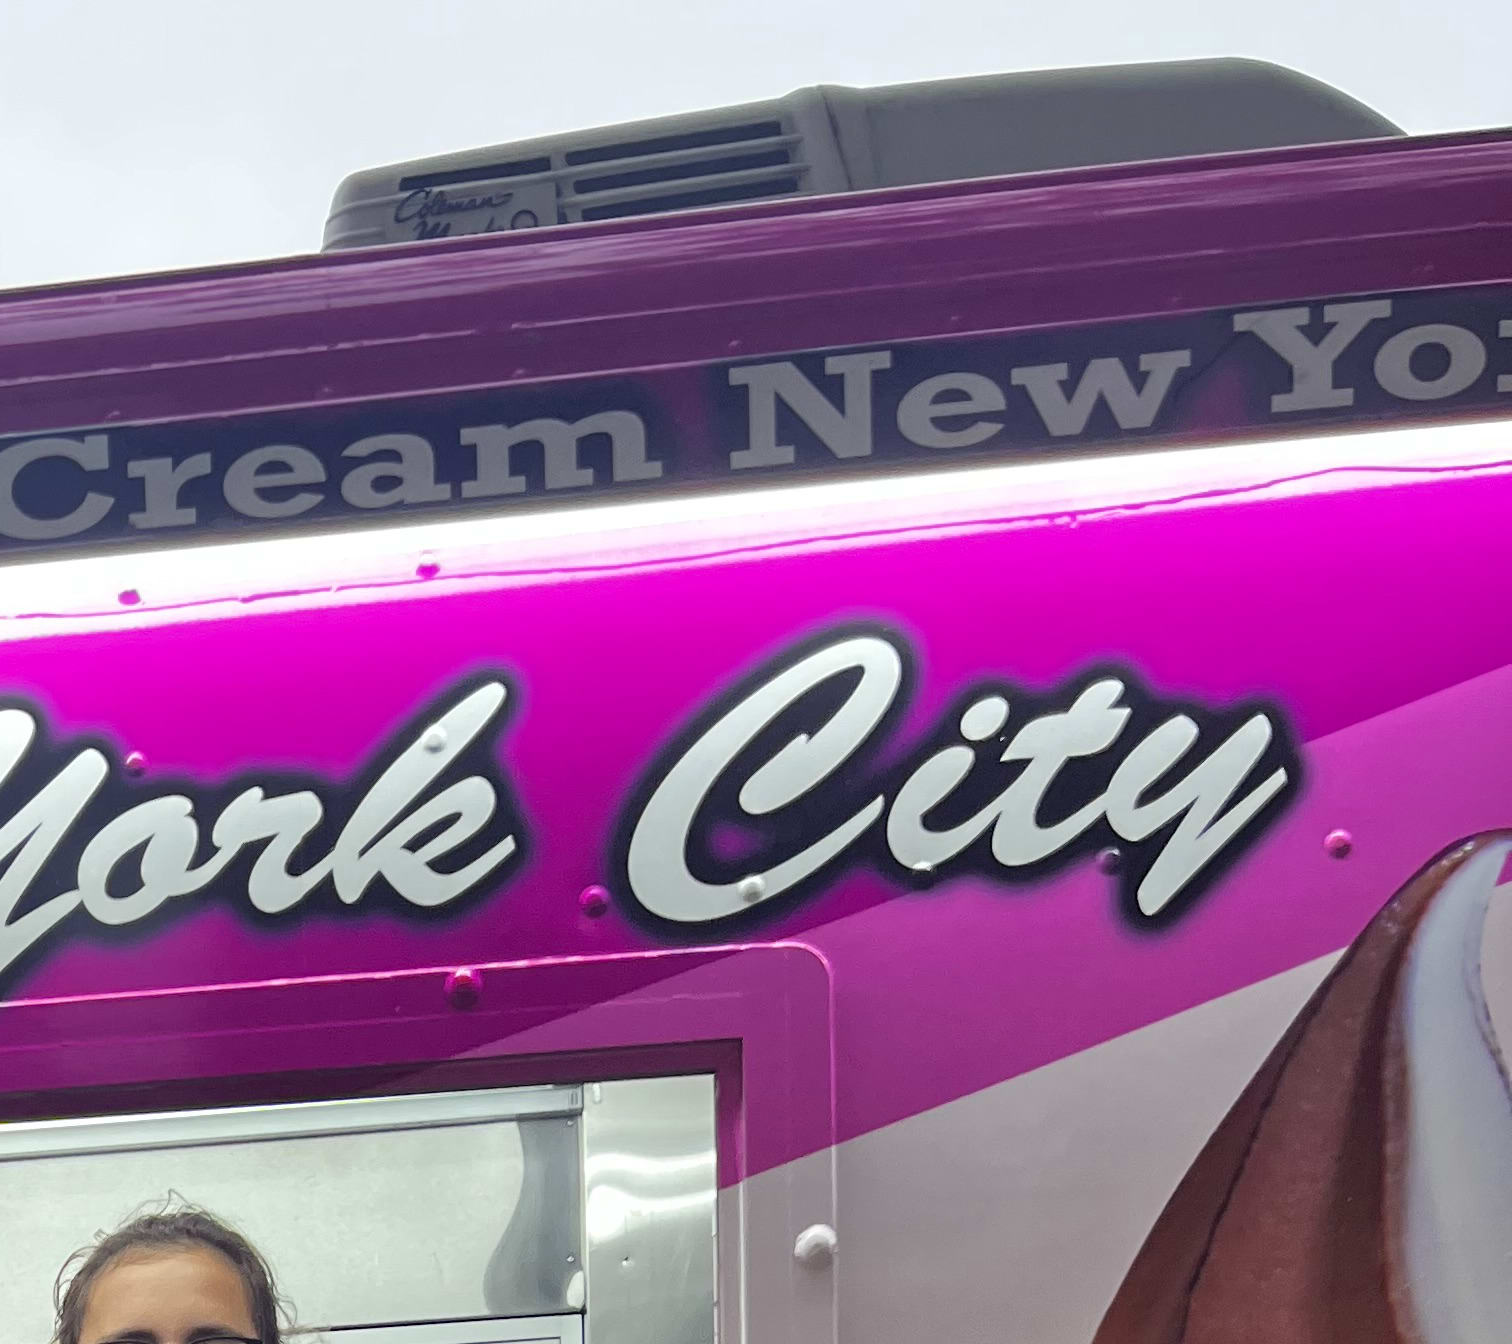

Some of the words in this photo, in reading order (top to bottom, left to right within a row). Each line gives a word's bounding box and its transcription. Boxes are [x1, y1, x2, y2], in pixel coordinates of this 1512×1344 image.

[728, 350, 1192, 473] New
[1233, 299, 1512, 412] Yo
[627, 637, 1287, 922] City
